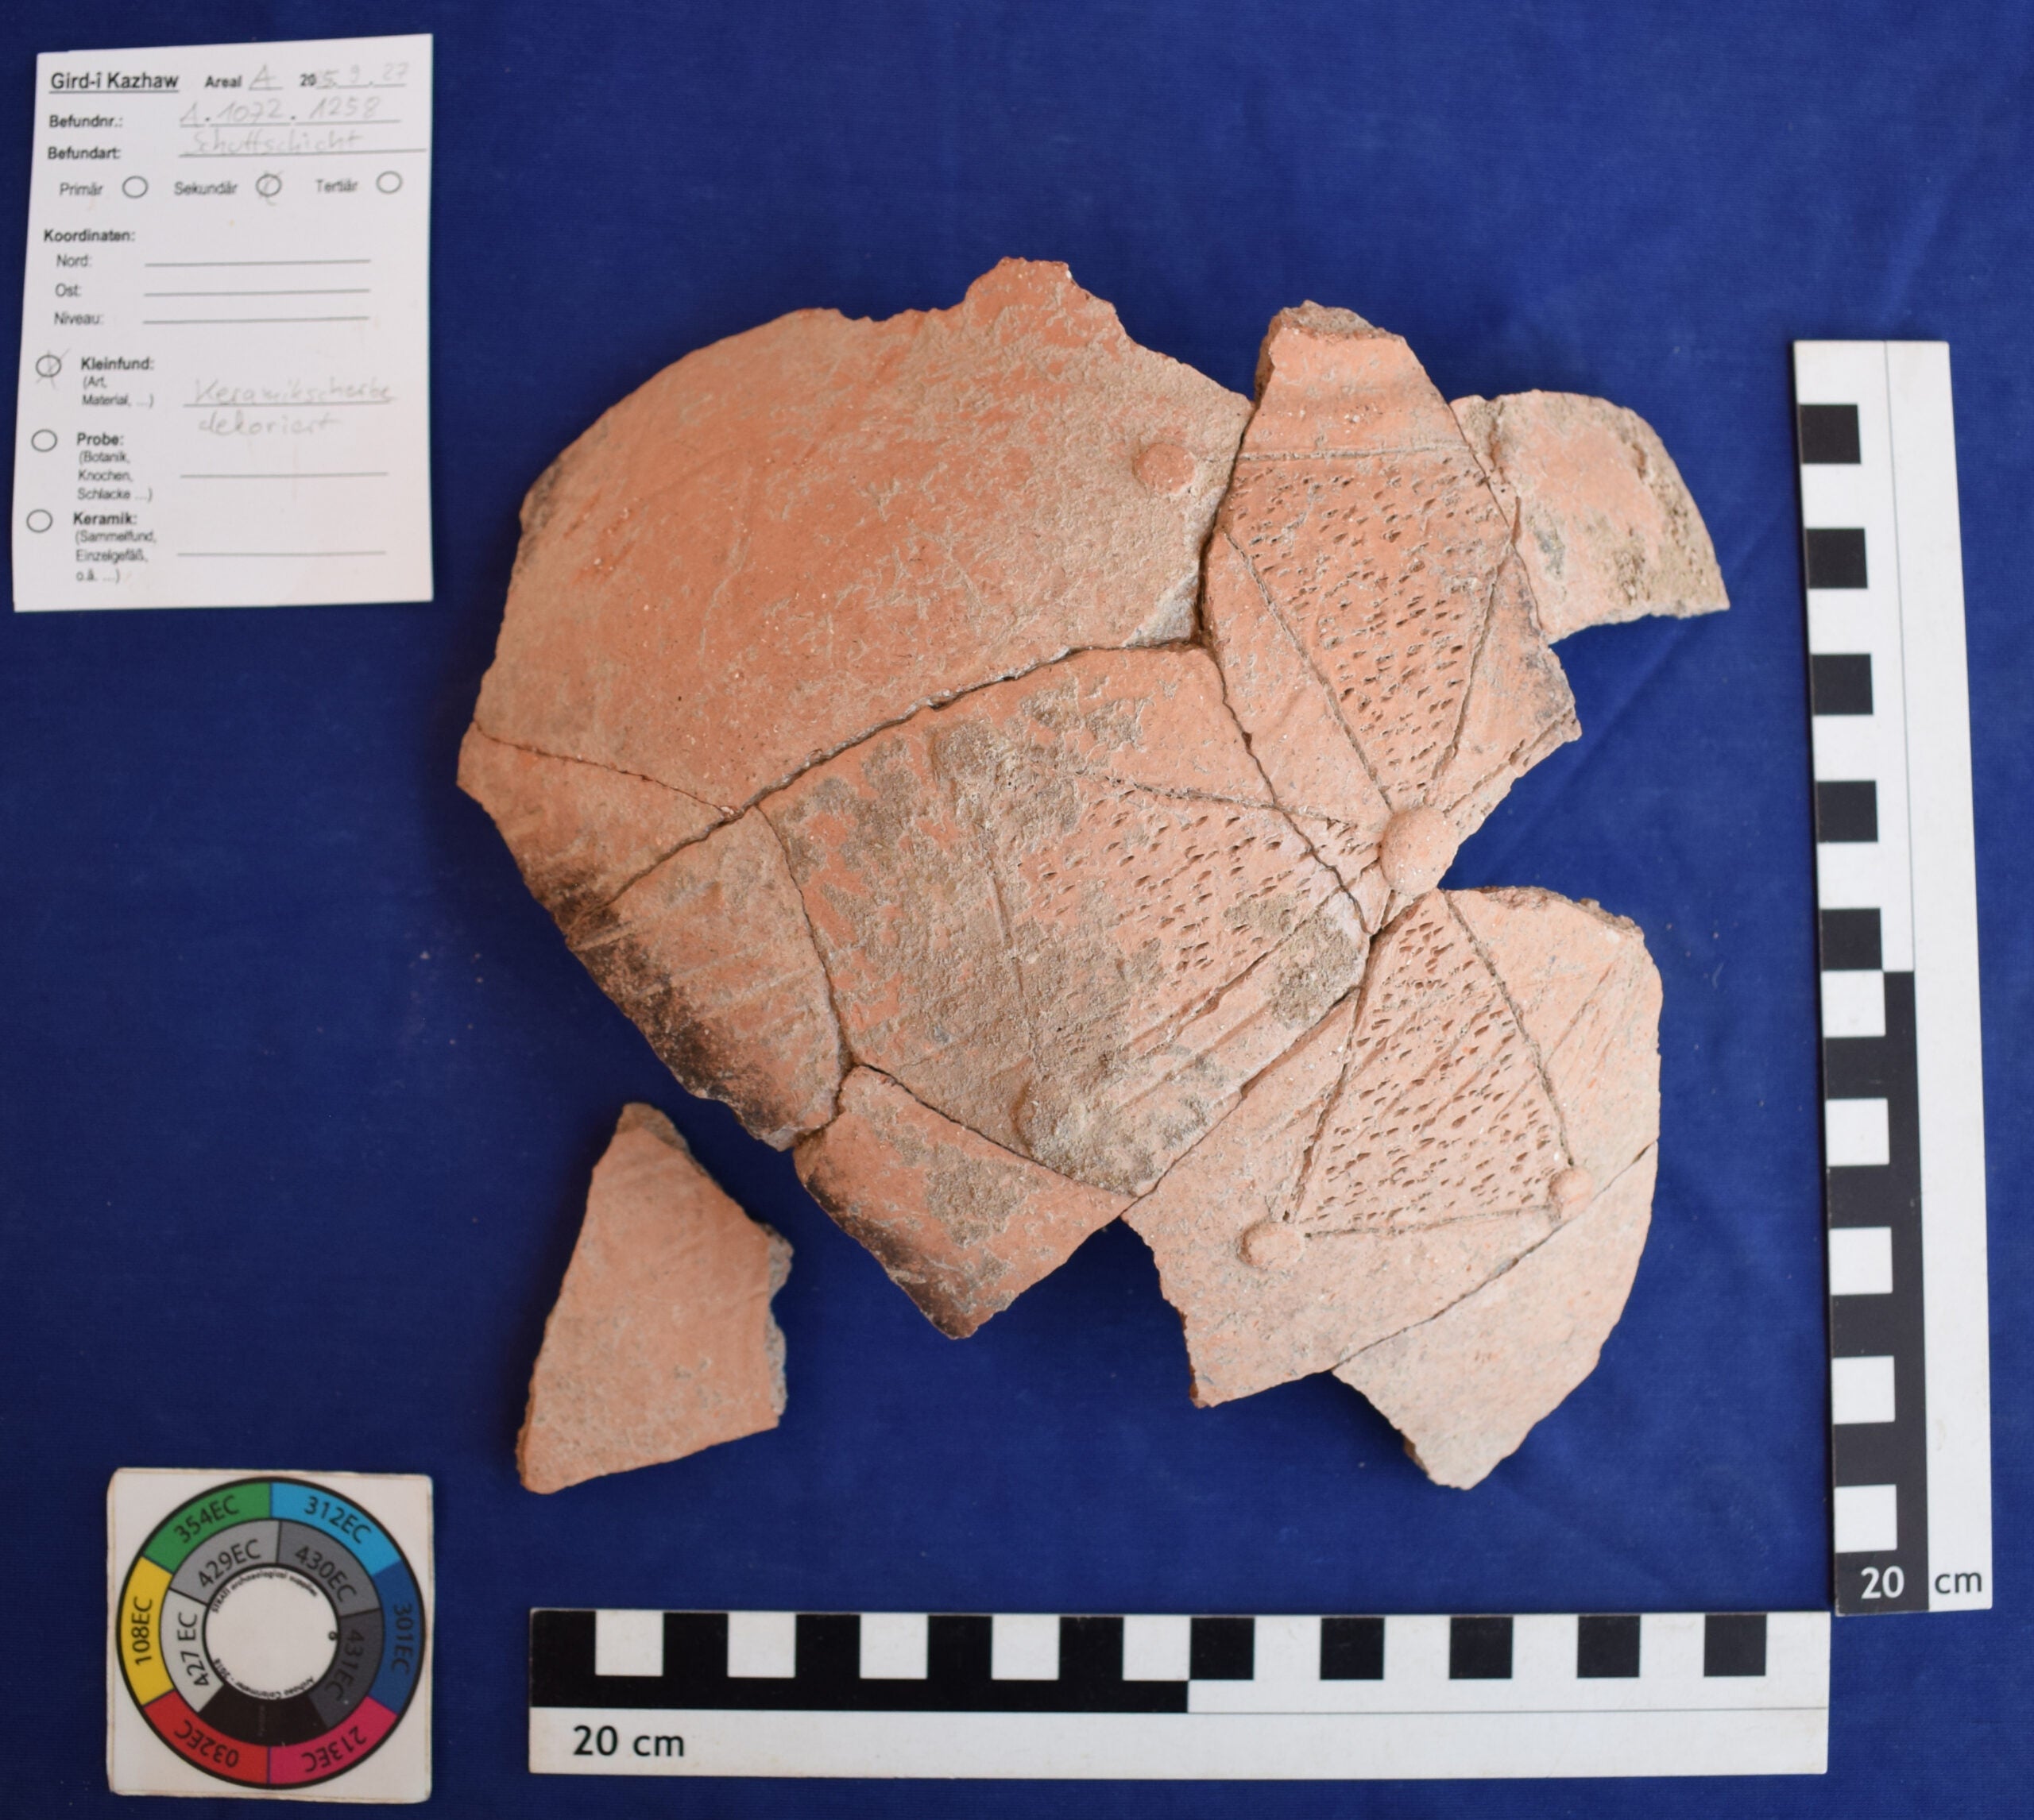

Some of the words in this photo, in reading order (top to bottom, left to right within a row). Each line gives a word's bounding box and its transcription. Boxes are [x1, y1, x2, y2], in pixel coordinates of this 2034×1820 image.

[108, 71, 179, 89] Kazhaw
[205, 75, 242, 88] Areal
[249, 64, 274, 89] A
[48, 114, 124, 128] Befundnr.:
[48, 146, 121, 160] Befundart:
[60, 182, 104, 195] Primär
[174, 181, 238, 195] Sekundär
[315, 179, 358, 193] Tertiär
[44, 229, 135, 242] Koordinaten:
[56, 254, 92, 268] Nord:
[55, 284, 82, 297] Ost:
[54, 312, 104, 326] Niveau:
[80, 357, 155, 371] Kleinfund:
[83, 377, 107, 390] (Art,
[82, 394, 131, 408] Material,
[77, 432, 124, 446] Probe:
[79, 450, 130, 465] (Botanik,
[78, 469, 133, 482] Knochen,
[77, 487, 130, 500] Schlacke
[73, 511, 137, 525] Keramik:
[75, 530, 157, 545] (Sammelfund,
[76, 548, 149, 564] Einzelgefäß,
[173, 1494, 240, 1544] 354EC
[304, 1496, 373, 1544] 312EC
[196, 1539, 261, 1588] 429EC
[294, 1545, 357, 1603] 430EC
[1861, 1566, 1904, 1599] 20
[1935, 1572, 1982, 1594] cm
[131, 1596, 153, 1666] 108EC
[177, 1611, 198, 1641] EC
[391, 1602, 414, 1675] 301EC
[180, 1651, 210, 1689] 427
[324, 1629, 365, 1701] 431EC
[172, 1719, 240, 1769] 032EC
[573, 1725, 617, 1756] 20
[632, 1735, 684, 1756] cm
[301, 1725, 367, 1773] 213EC
